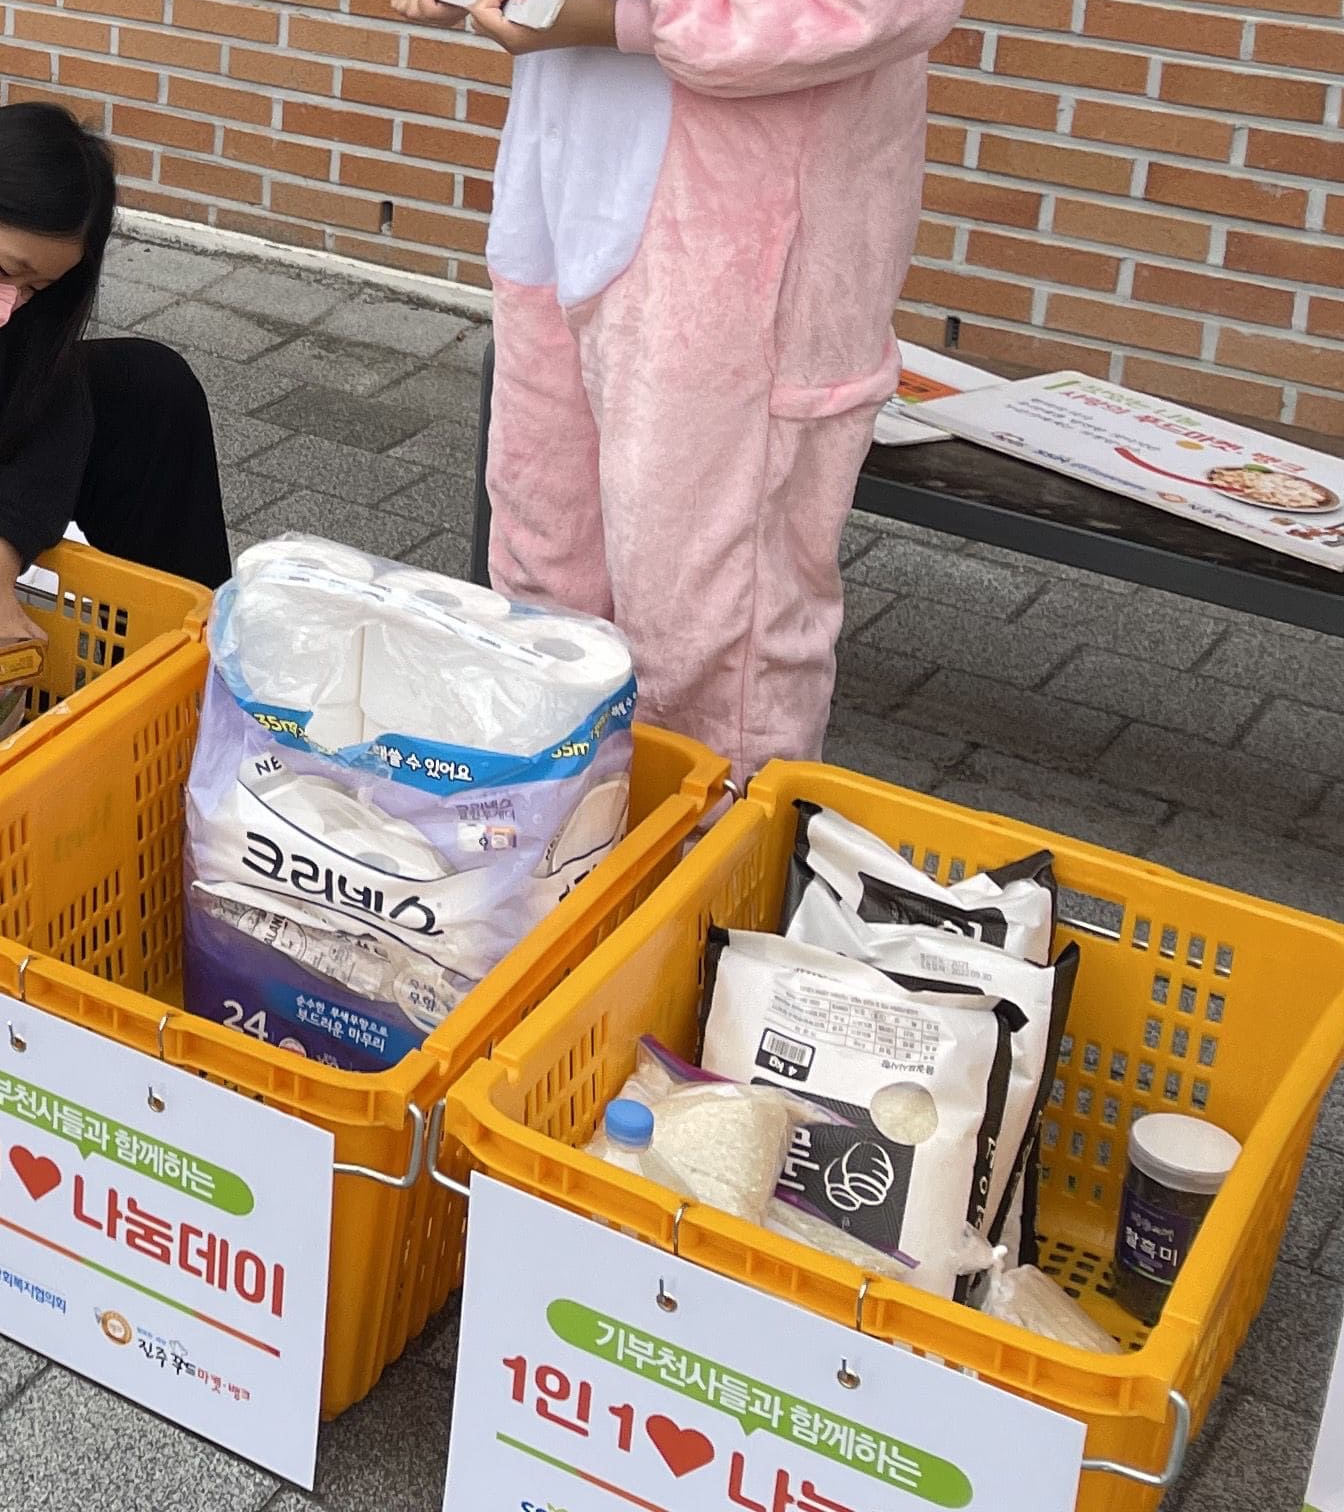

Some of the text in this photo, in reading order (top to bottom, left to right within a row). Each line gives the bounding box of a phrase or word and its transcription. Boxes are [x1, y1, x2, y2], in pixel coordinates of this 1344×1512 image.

[425, 758, 472, 783] 있어요
[242, 831, 445, 936] 크리넥스
[223, 1000, 268, 1041] 24
[114, 1129, 216, 1198] 함께하는
[73, 1175, 284, 1317] 나눔데이
[502, 1355, 593, 1437] 1인
[595, 1320, 922, 1489] 기부천사들과 함께하는
